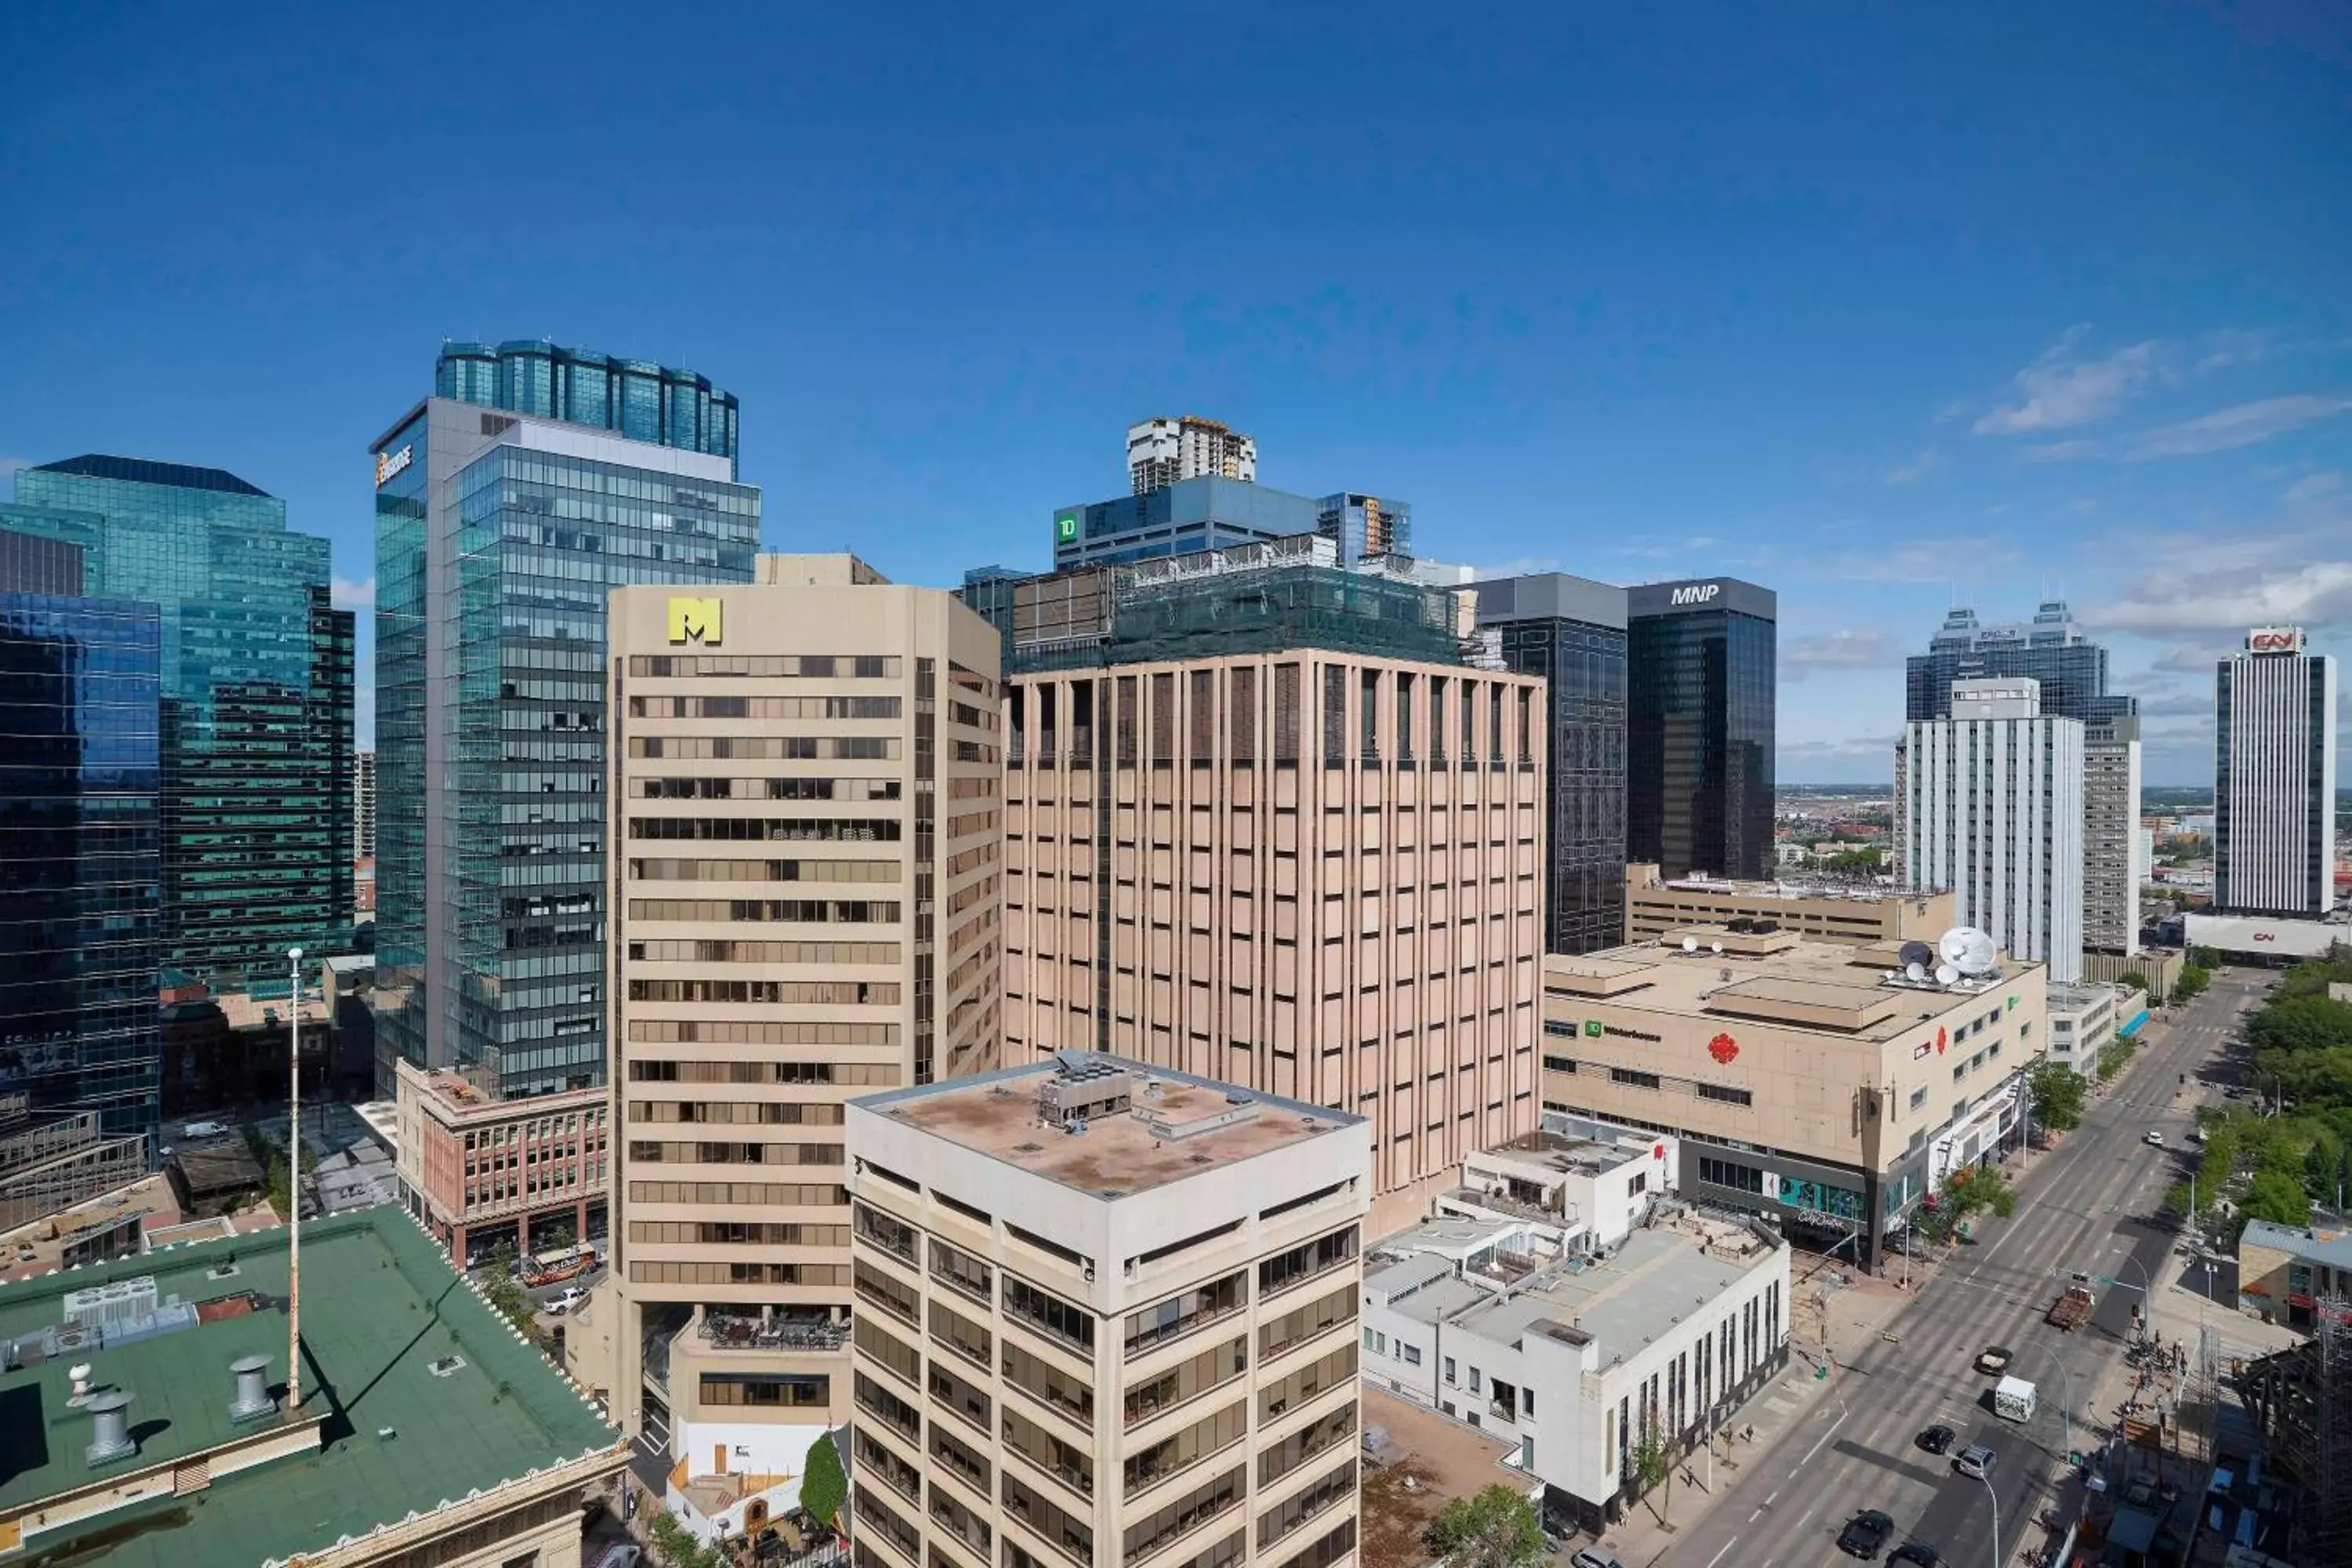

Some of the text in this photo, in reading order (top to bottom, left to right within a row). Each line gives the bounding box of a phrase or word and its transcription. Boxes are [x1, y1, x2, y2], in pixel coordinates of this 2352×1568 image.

[1059, 520, 1075, 536] TD
[1671, 584, 1719, 605] MNP
[2253, 633, 2293, 650] CN
[2253, 933, 2275, 942] CN
